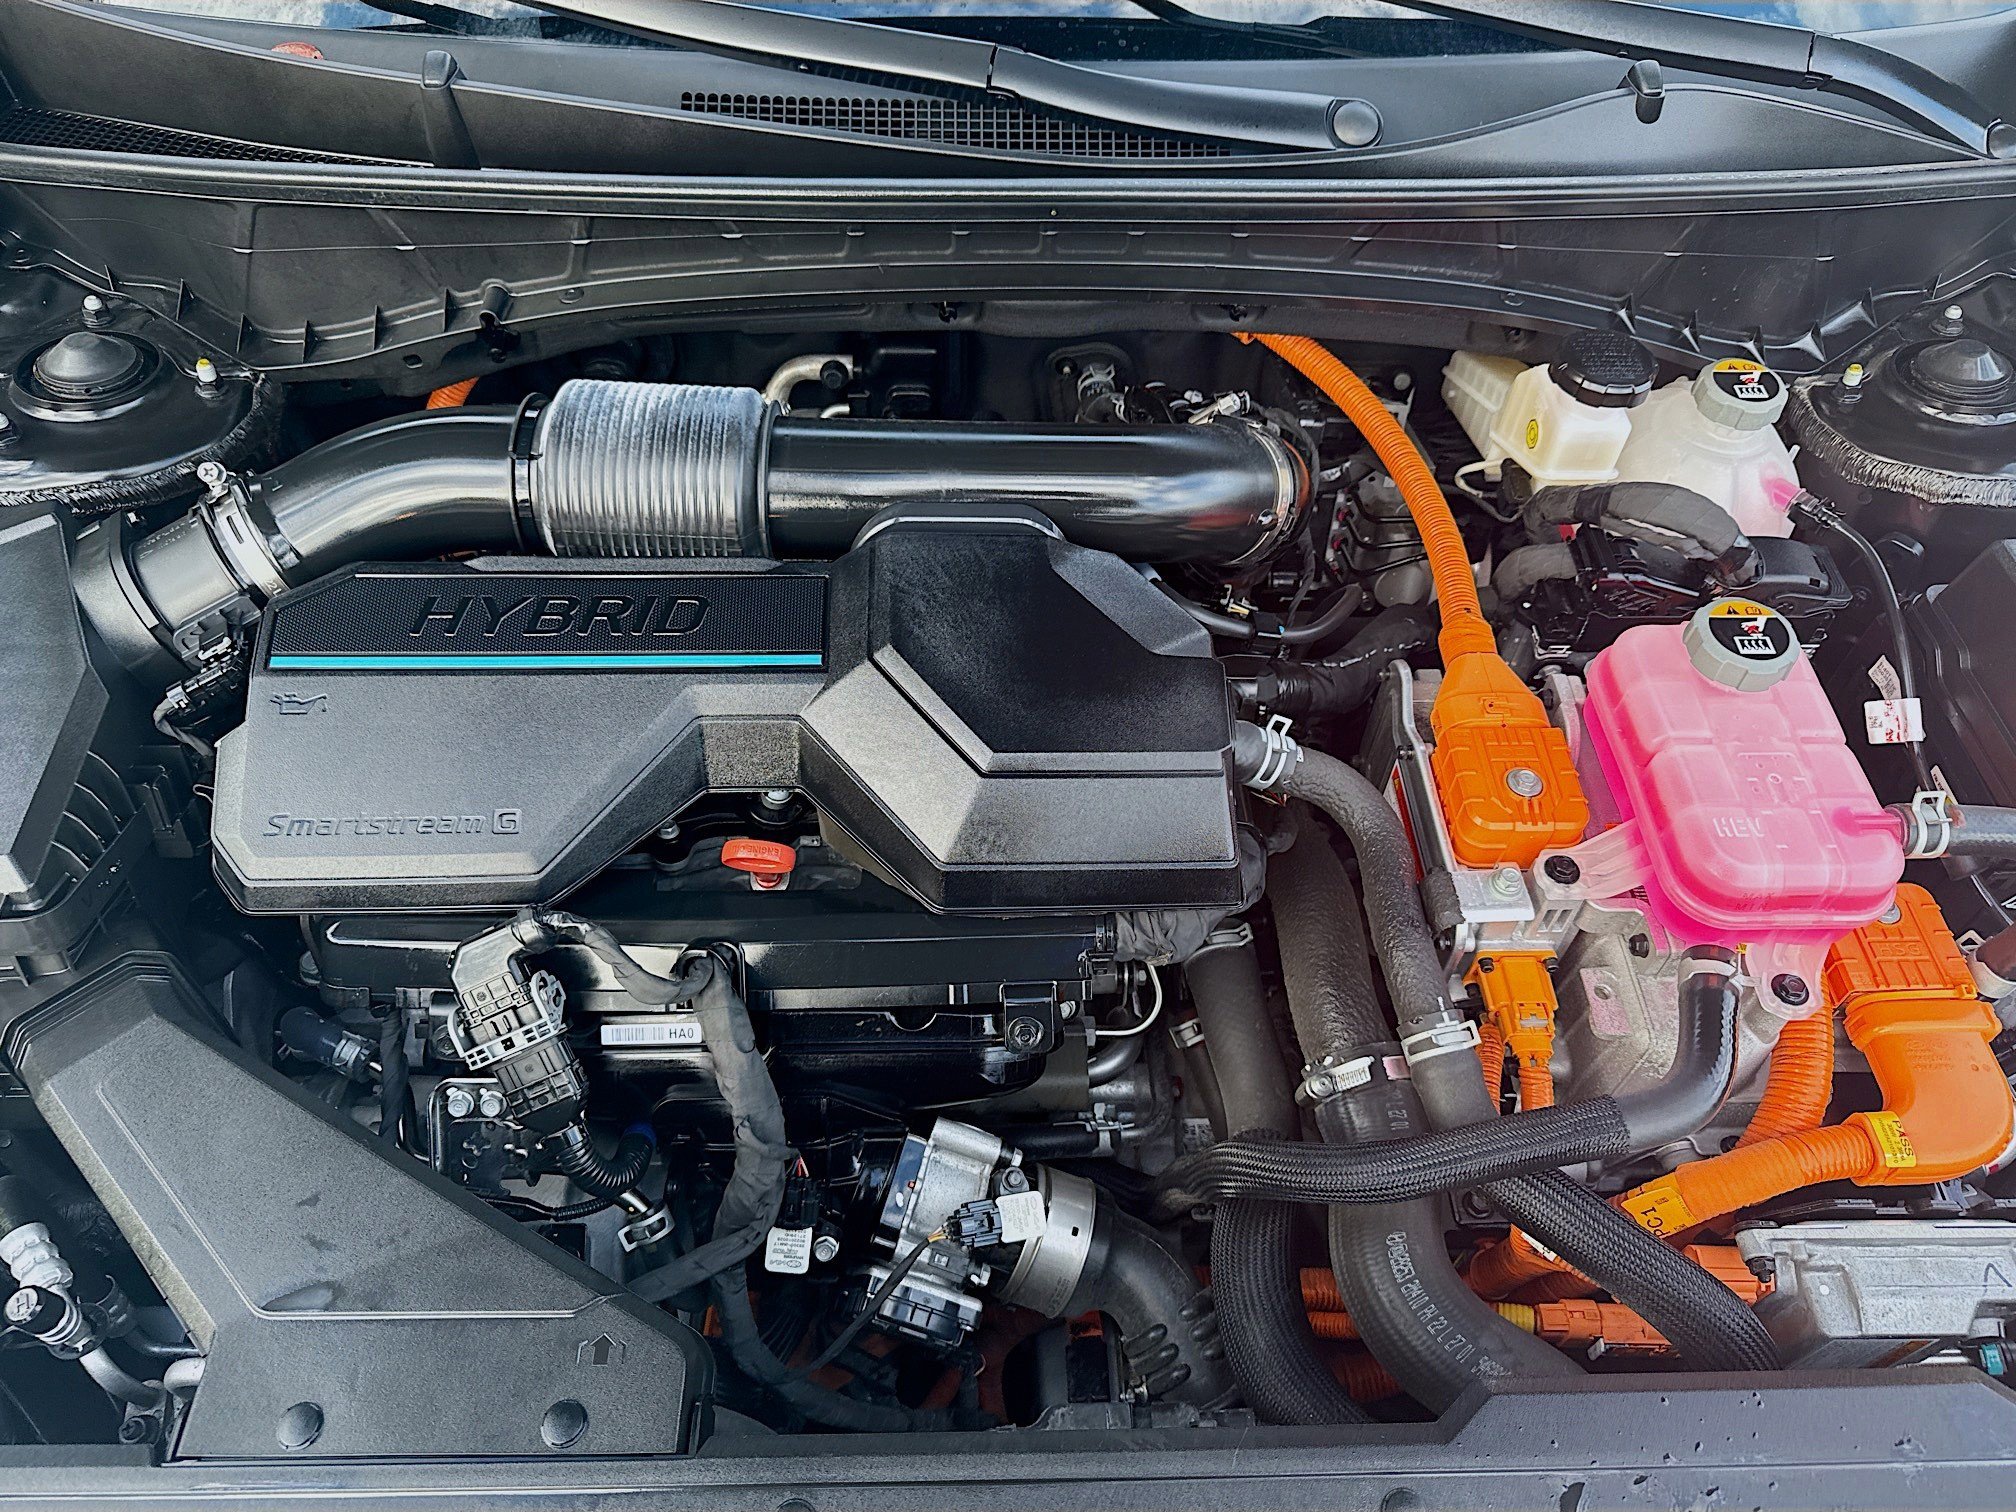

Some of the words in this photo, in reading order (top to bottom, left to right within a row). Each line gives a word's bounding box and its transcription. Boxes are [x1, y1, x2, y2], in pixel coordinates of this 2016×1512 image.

[410, 595, 711, 636] HYBRID
[263, 812, 486, 838] Smartstream
[493, 809, 521, 834] G
[1713, 817, 1765, 838] HEV
[748, 845, 780, 856] ENGINE
[1892, 1120, 1914, 1157] PASS
[1417, 1303, 1439, 1324] PH
[1427, 1316, 1448, 1335] 22
[1437, 1326, 1454, 1344] L
[1444, 1333, 1467, 1352] 27
